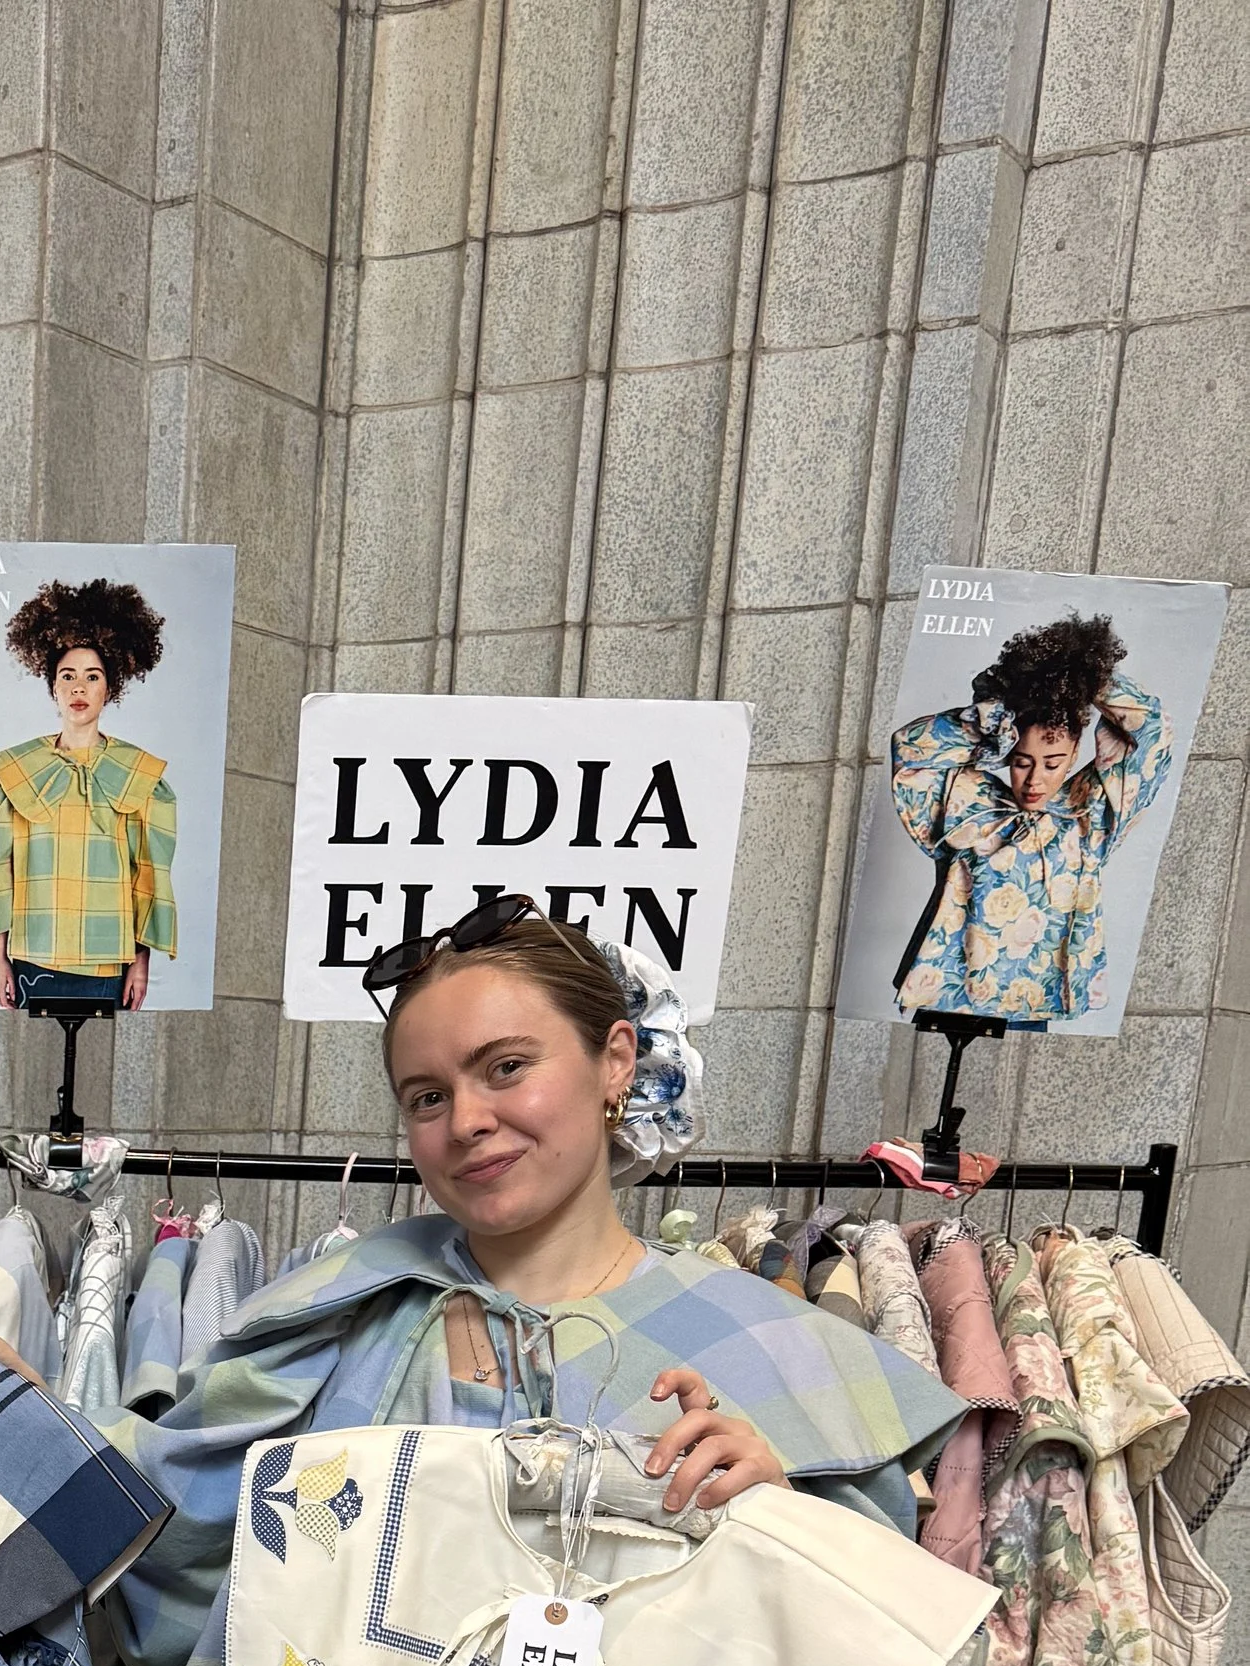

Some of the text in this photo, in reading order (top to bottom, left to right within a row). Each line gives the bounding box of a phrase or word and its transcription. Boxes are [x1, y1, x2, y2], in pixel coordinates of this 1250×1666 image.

[926, 578, 994, 601] LYDIA
[920, 614, 994, 637] ELLEN
[327, 757, 698, 849] LYDIA
